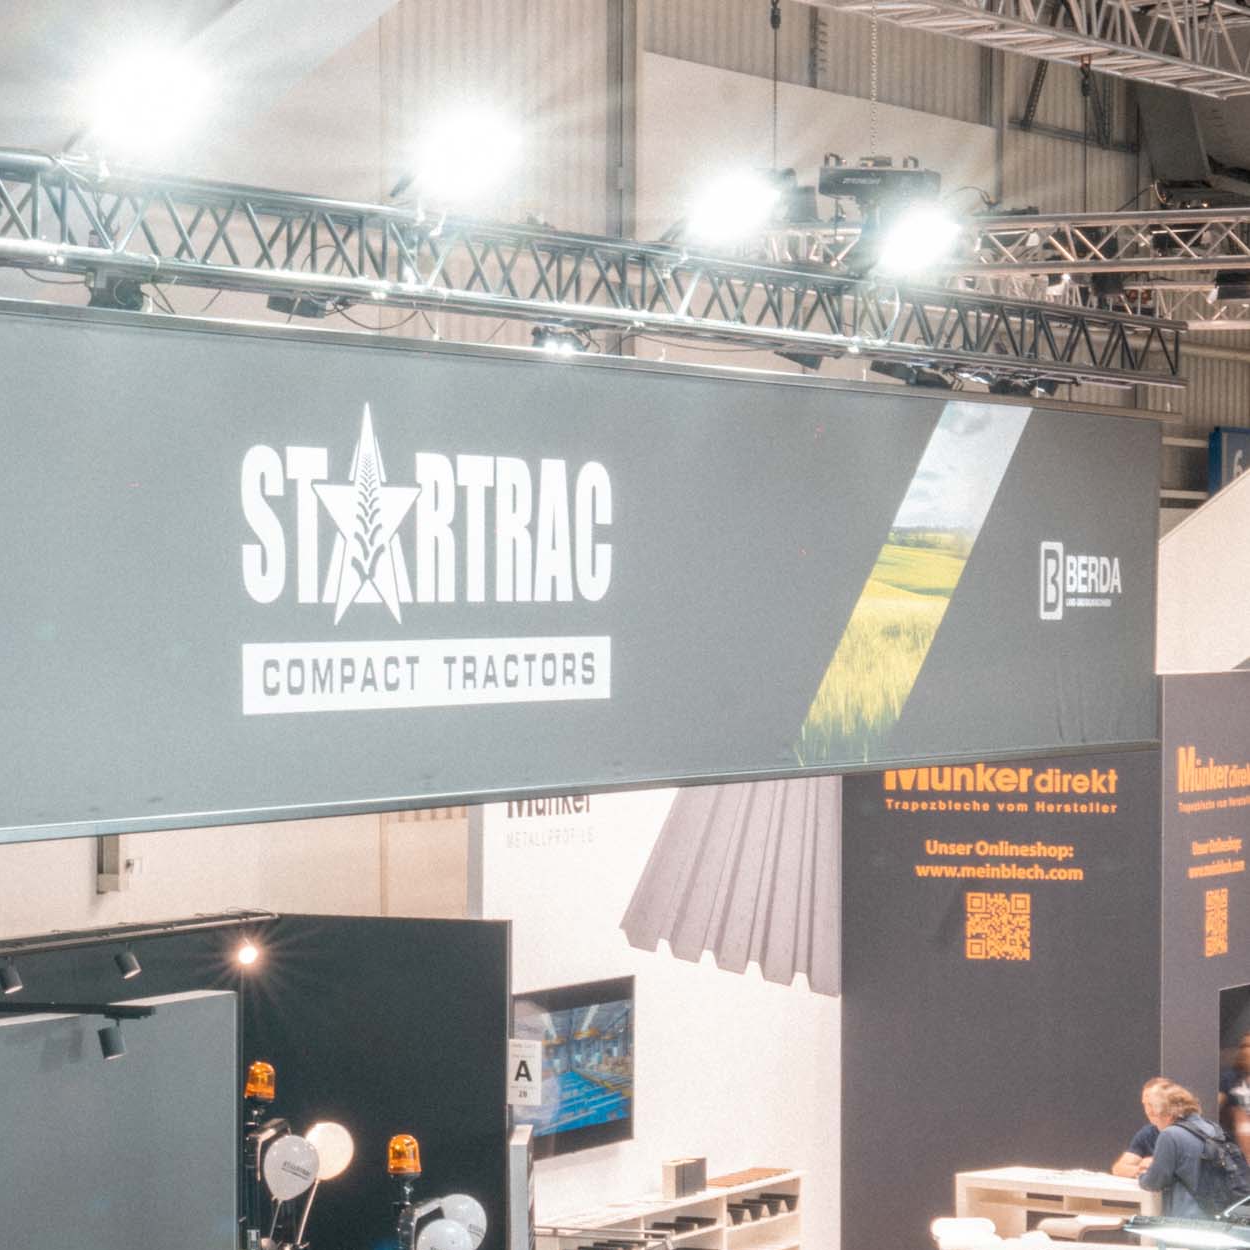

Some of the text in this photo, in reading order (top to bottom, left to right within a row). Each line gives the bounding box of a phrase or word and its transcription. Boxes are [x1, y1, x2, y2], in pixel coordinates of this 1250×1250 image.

[240, 401, 613, 627] STARTRAC
[1066, 555, 1122, 594] BERDA
[262, 651, 596, 697] COMPACT TRACTORS
[1034, 767, 1119, 795] direkt
[885, 798, 1118, 813] Trapezbleche vom Hersteller
[925, 838, 1075, 861] Unser Onlineshop:
[914, 863, 1085, 881] www.meinblech.com
[514, 1059, 533, 1082] A
